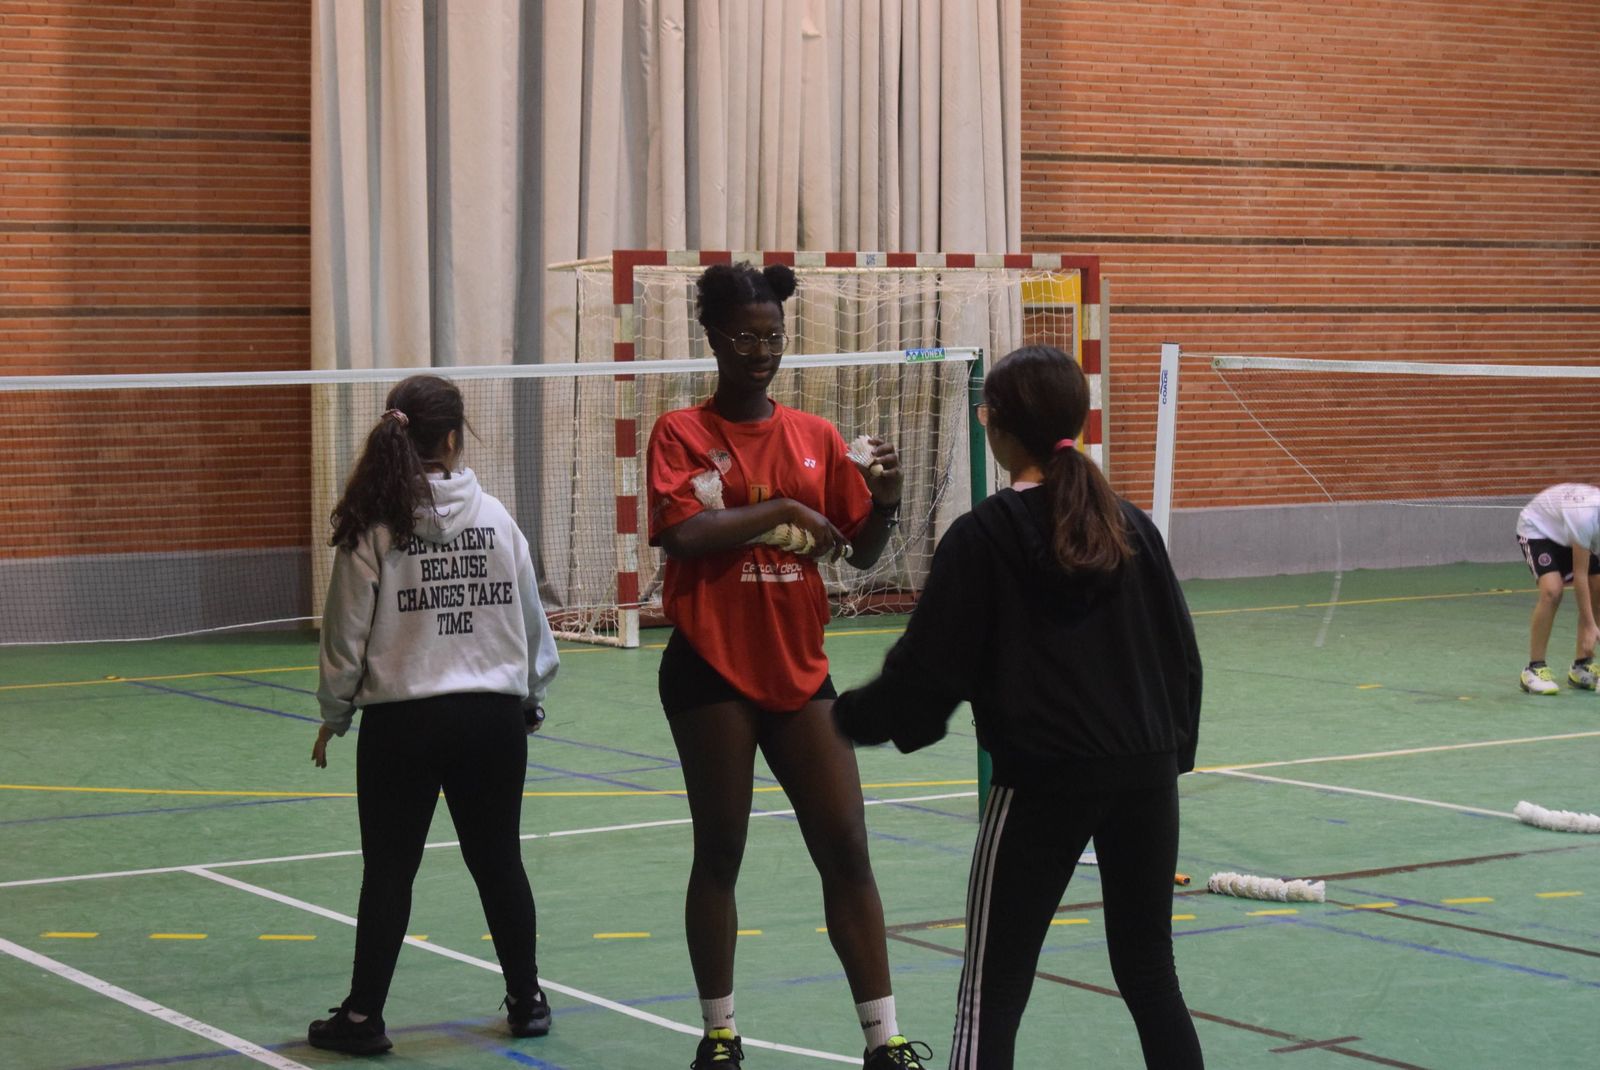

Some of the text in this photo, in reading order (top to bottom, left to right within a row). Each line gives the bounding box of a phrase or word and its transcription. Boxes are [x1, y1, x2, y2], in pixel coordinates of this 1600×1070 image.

[920, 348, 944, 359] YONEX
[408, 534, 427, 556] BE
[420, 555, 487, 582] BECAUSE
[397, 582, 512, 612] CHANGES TAKE
[437, 611, 474, 635] TIME
